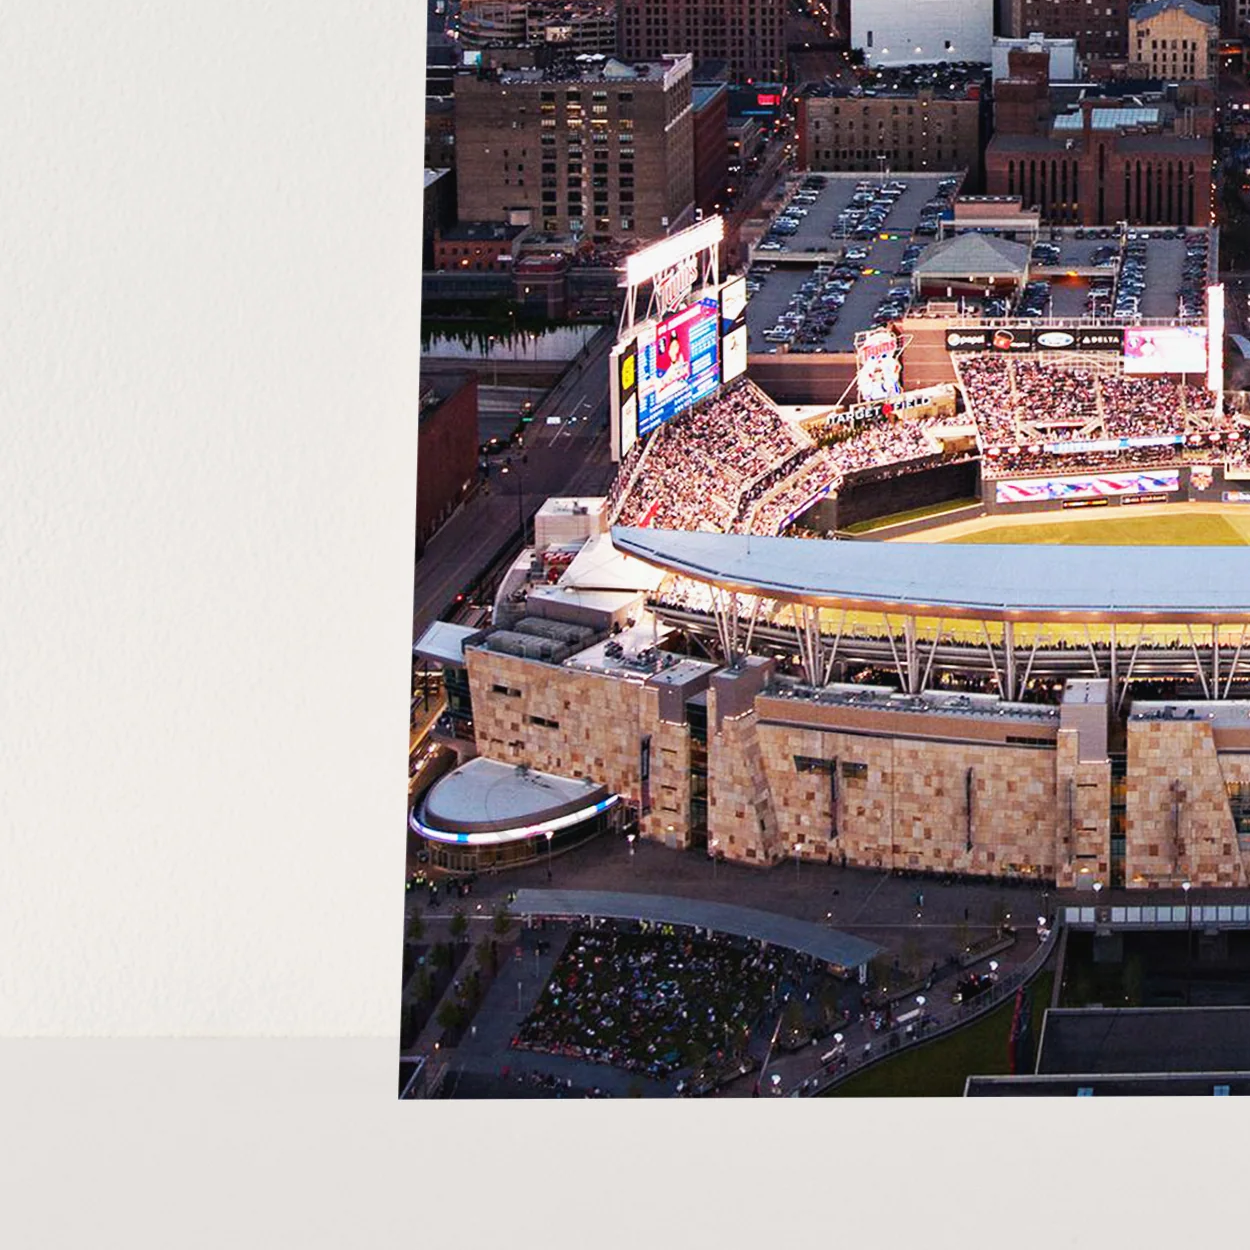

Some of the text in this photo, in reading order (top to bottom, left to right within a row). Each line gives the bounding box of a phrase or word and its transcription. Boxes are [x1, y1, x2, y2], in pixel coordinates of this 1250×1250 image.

[1091, 335, 1120, 344] DELTA
[826, 397, 933, 426] TARGET FIELD
